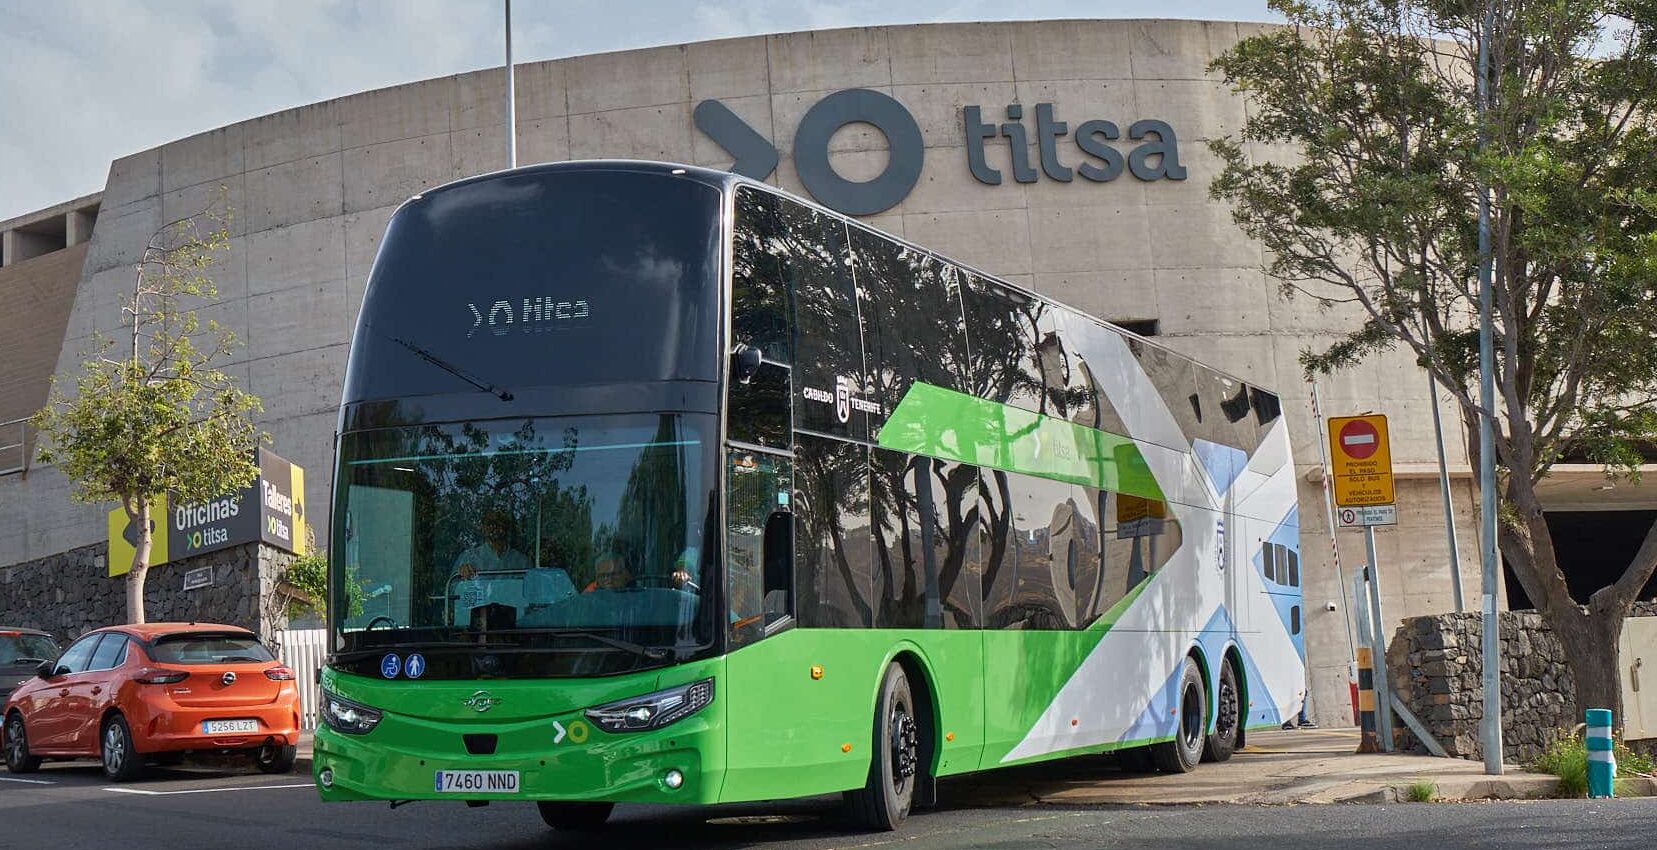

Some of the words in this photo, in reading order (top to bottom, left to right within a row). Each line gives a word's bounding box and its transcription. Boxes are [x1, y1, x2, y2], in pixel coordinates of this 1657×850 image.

[963, 102, 1187, 186] titsa
[262, 479, 292, 516] Talleres
[176, 497, 239, 531] Oficinas
[203, 527, 228, 546] titsa
[276, 518, 290, 540] titsa
[211, 721, 235, 732] 5256
[237, 721, 255, 731] LZT
[445, 773, 483, 789] 7460
[488, 773, 516, 789] NND
